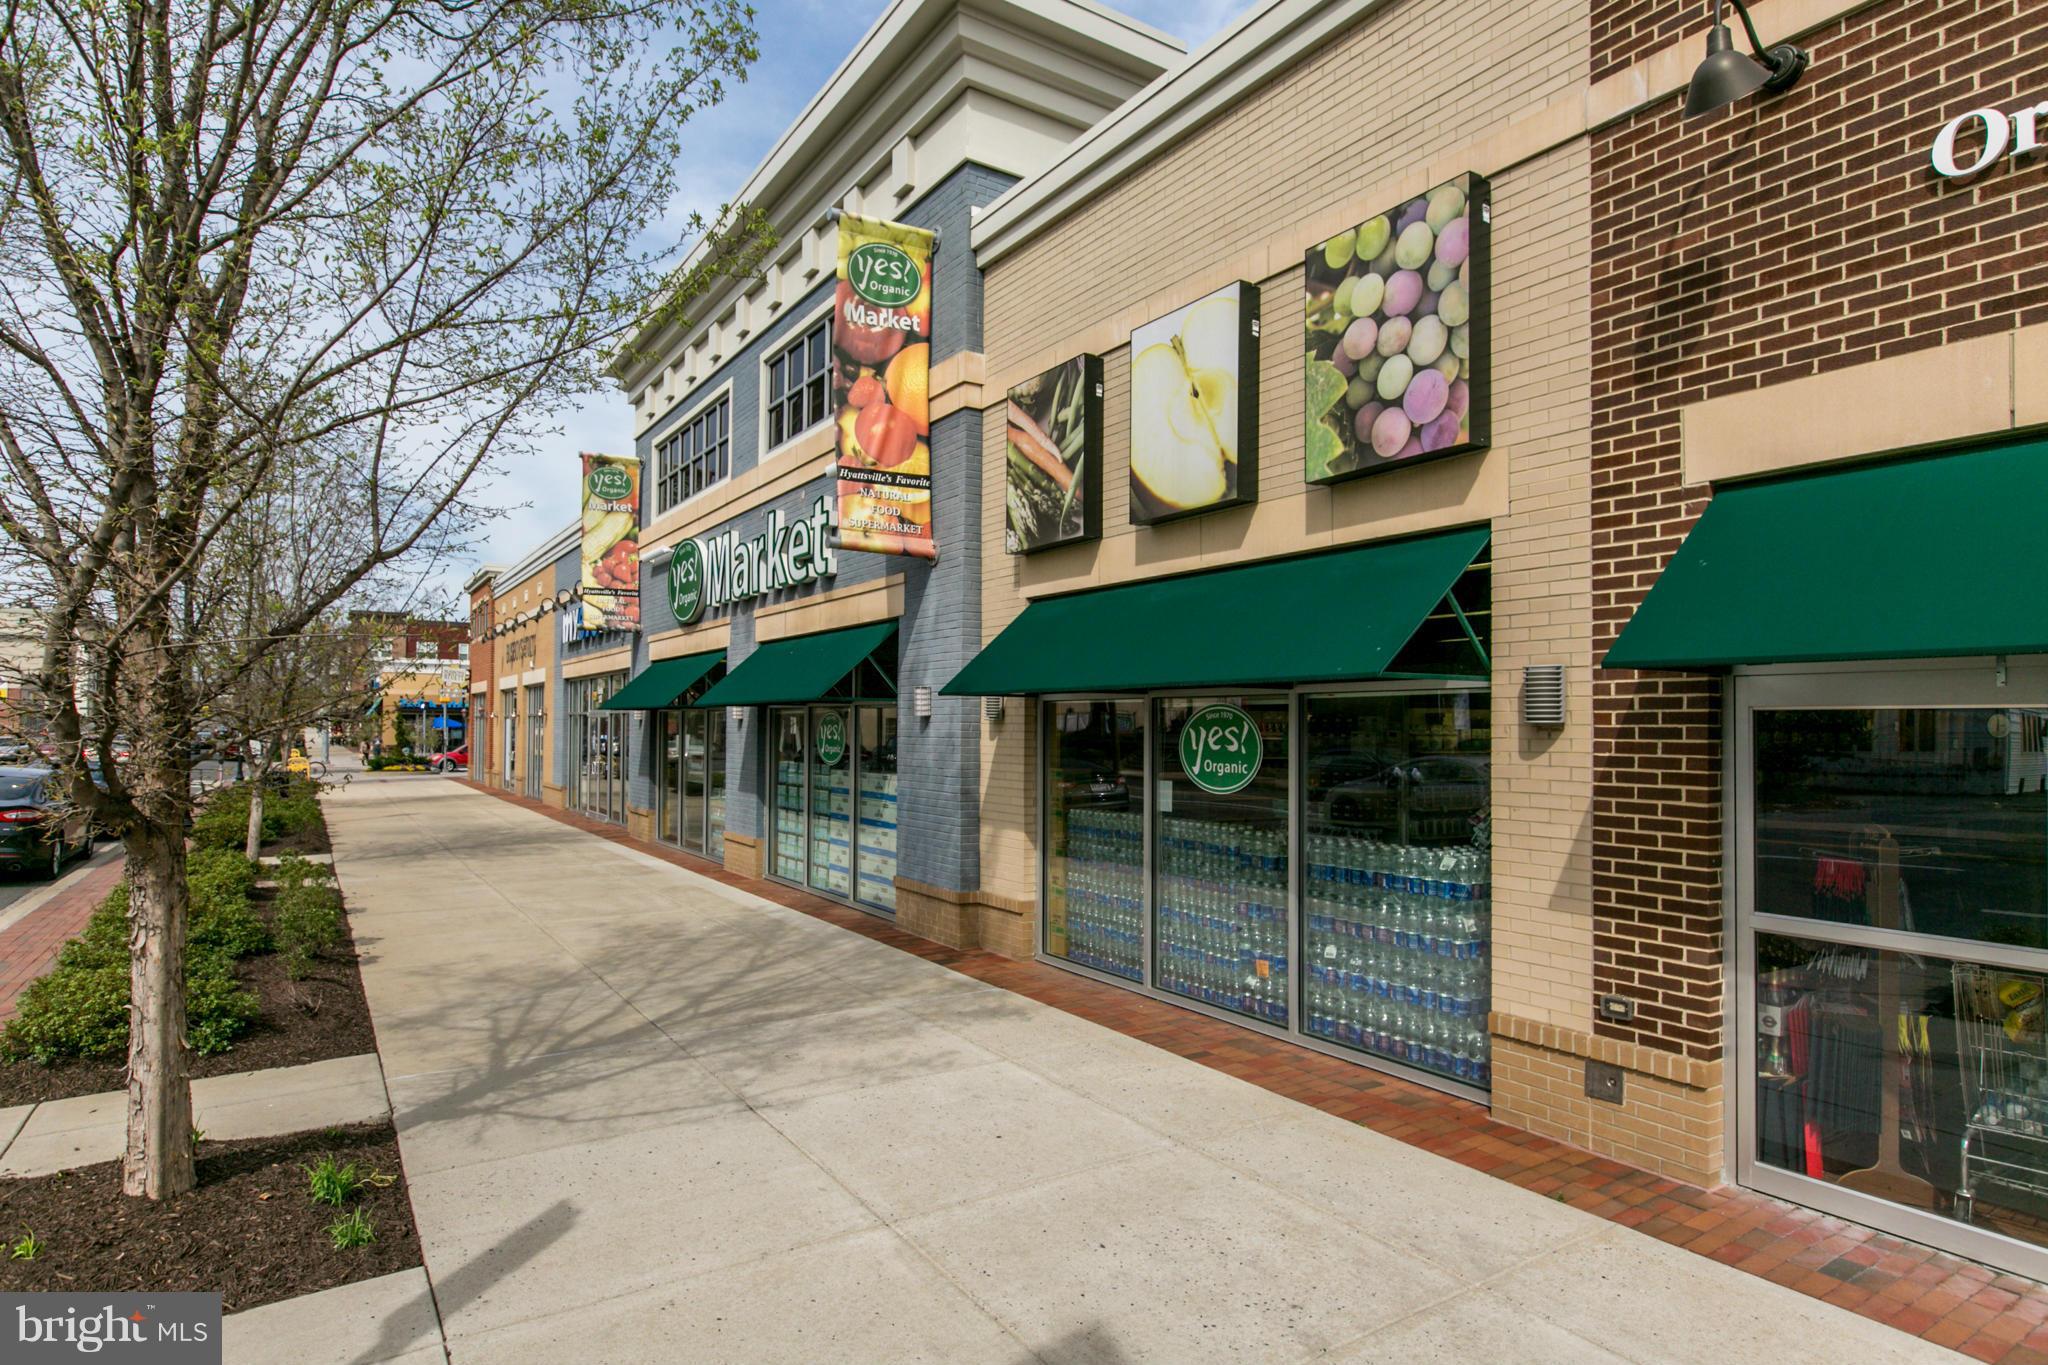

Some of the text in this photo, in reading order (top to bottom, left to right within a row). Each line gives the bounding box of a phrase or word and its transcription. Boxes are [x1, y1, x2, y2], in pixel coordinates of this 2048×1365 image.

[857, 254, 912, 290] yes!
[870, 280, 910, 296] Organic
[846, 302, 921, 332] Market
[593, 473, 627, 493] yes!
[840, 468, 931, 487] Hyattsville's Favorite
[859, 487, 912, 502] NATURAL
[589, 500, 633, 513] Market
[871, 505, 901, 517] FOOD
[849, 518, 924, 535] SUPERMARKET
[706, 496, 837, 607] Market
[672, 551, 698, 610] yes!
[679, 588, 698, 606] Organic
[820, 723, 842, 754] yes!
[1188, 721, 1249, 775] yes!
[1203, 759, 1248, 776] Organic
